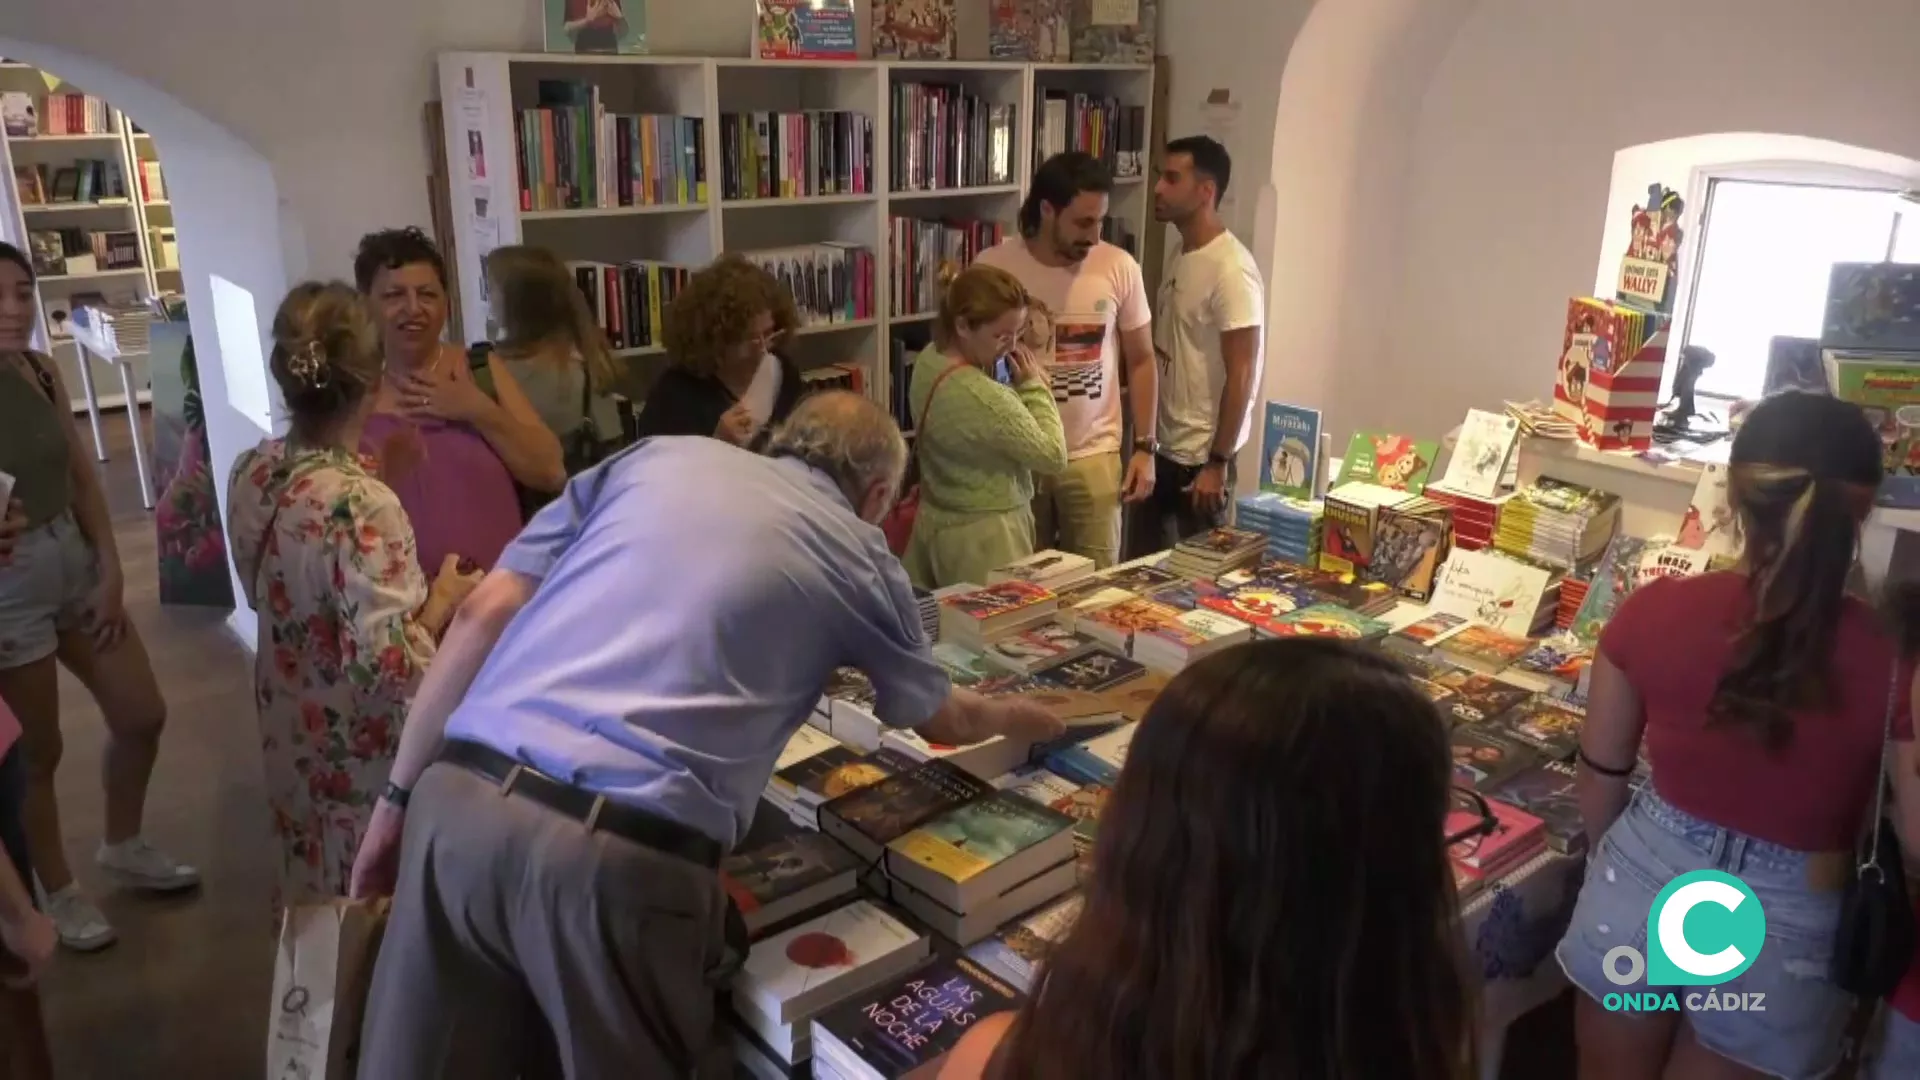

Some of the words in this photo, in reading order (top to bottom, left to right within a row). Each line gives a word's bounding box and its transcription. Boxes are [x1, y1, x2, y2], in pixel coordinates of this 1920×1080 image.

[1623, 275, 1657, 295] WALLY?
[905, 979, 976, 1026] AGUJAS
[943, 976, 983, 1004] LAS
[861, 1001, 929, 1051] NOCHE
[891, 994, 922, 1017] DE
[914, 1011, 943, 1034] LA
